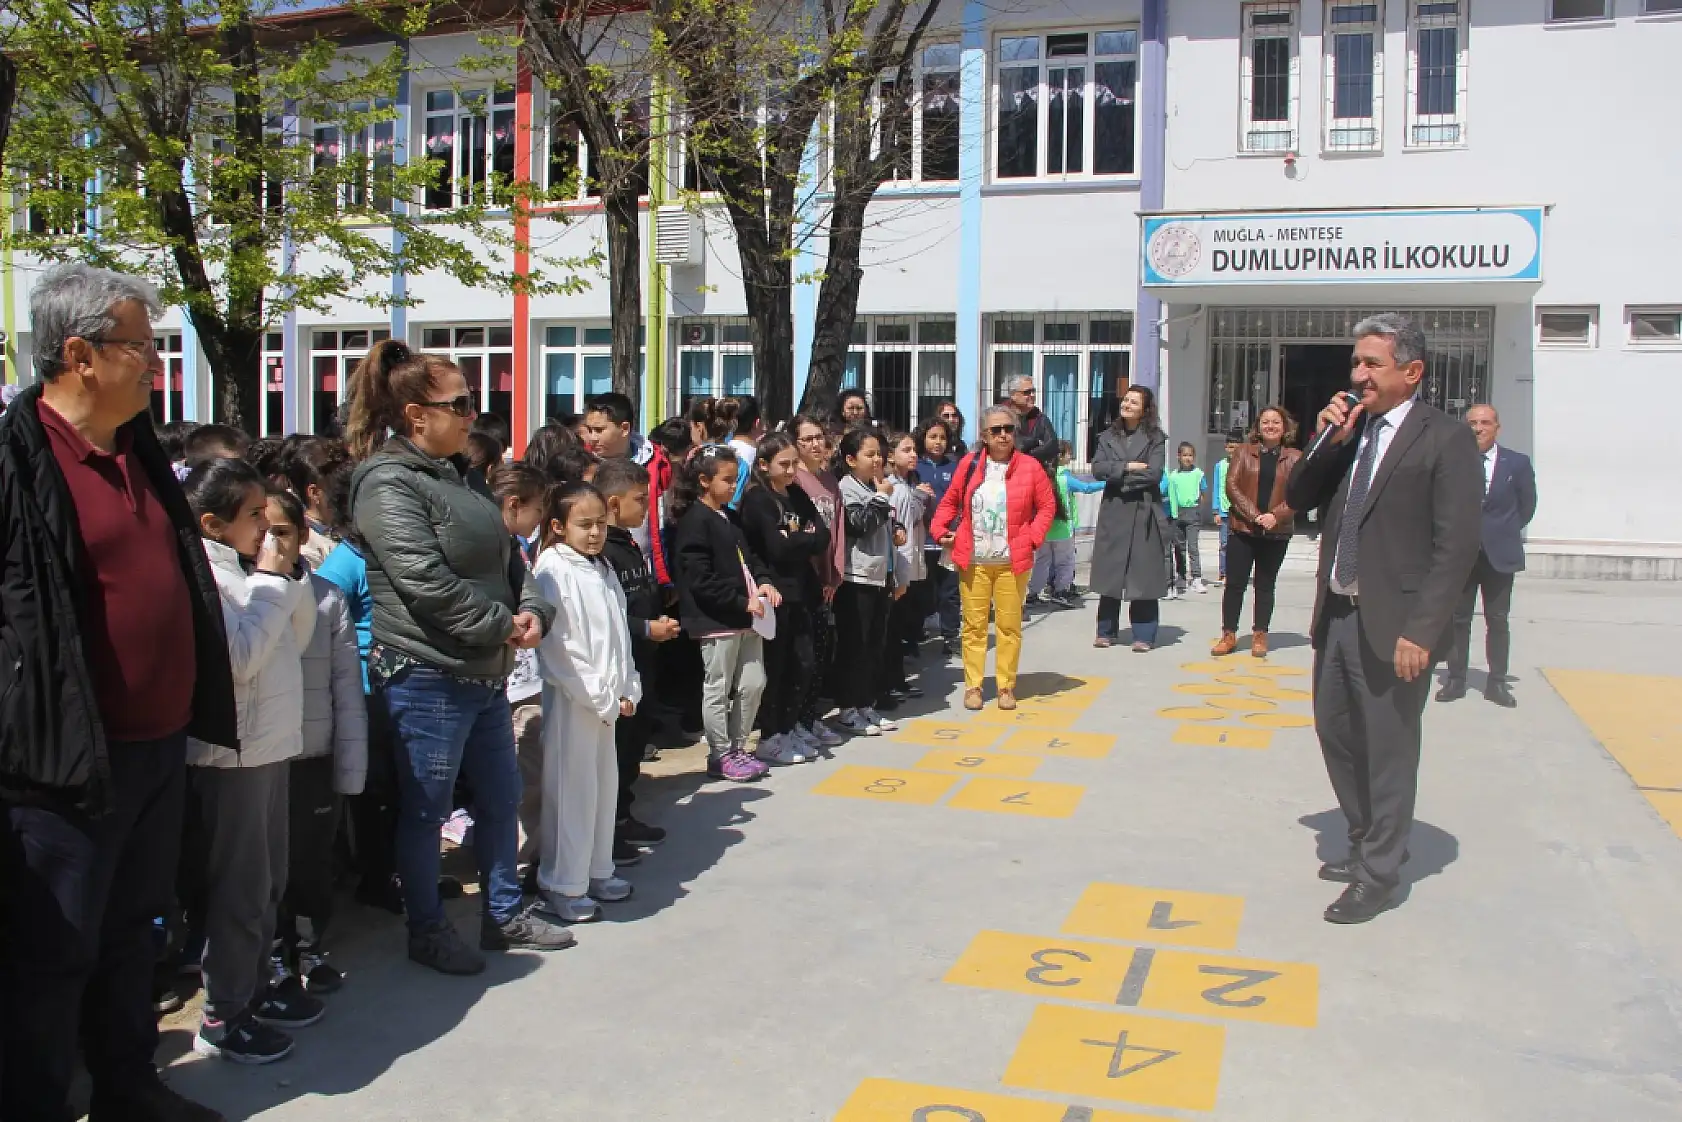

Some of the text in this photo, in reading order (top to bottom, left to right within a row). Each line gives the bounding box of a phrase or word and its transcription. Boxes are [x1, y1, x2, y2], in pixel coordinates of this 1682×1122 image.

[1213, 226, 1265, 242] MUĞLA
[1277, 226, 1343, 244] MENTEŞE
[1212, 240, 1510, 272] DUMLUPINAR İLKOKULU
[864, 777, 907, 795] 8
[999, 791, 1034, 806] 7
[1146, 900, 1202, 930] 1
[1025, 948, 1092, 987] 3
[1198, 963, 1283, 1008] 2
[1080, 1029, 1181, 1080] 4
